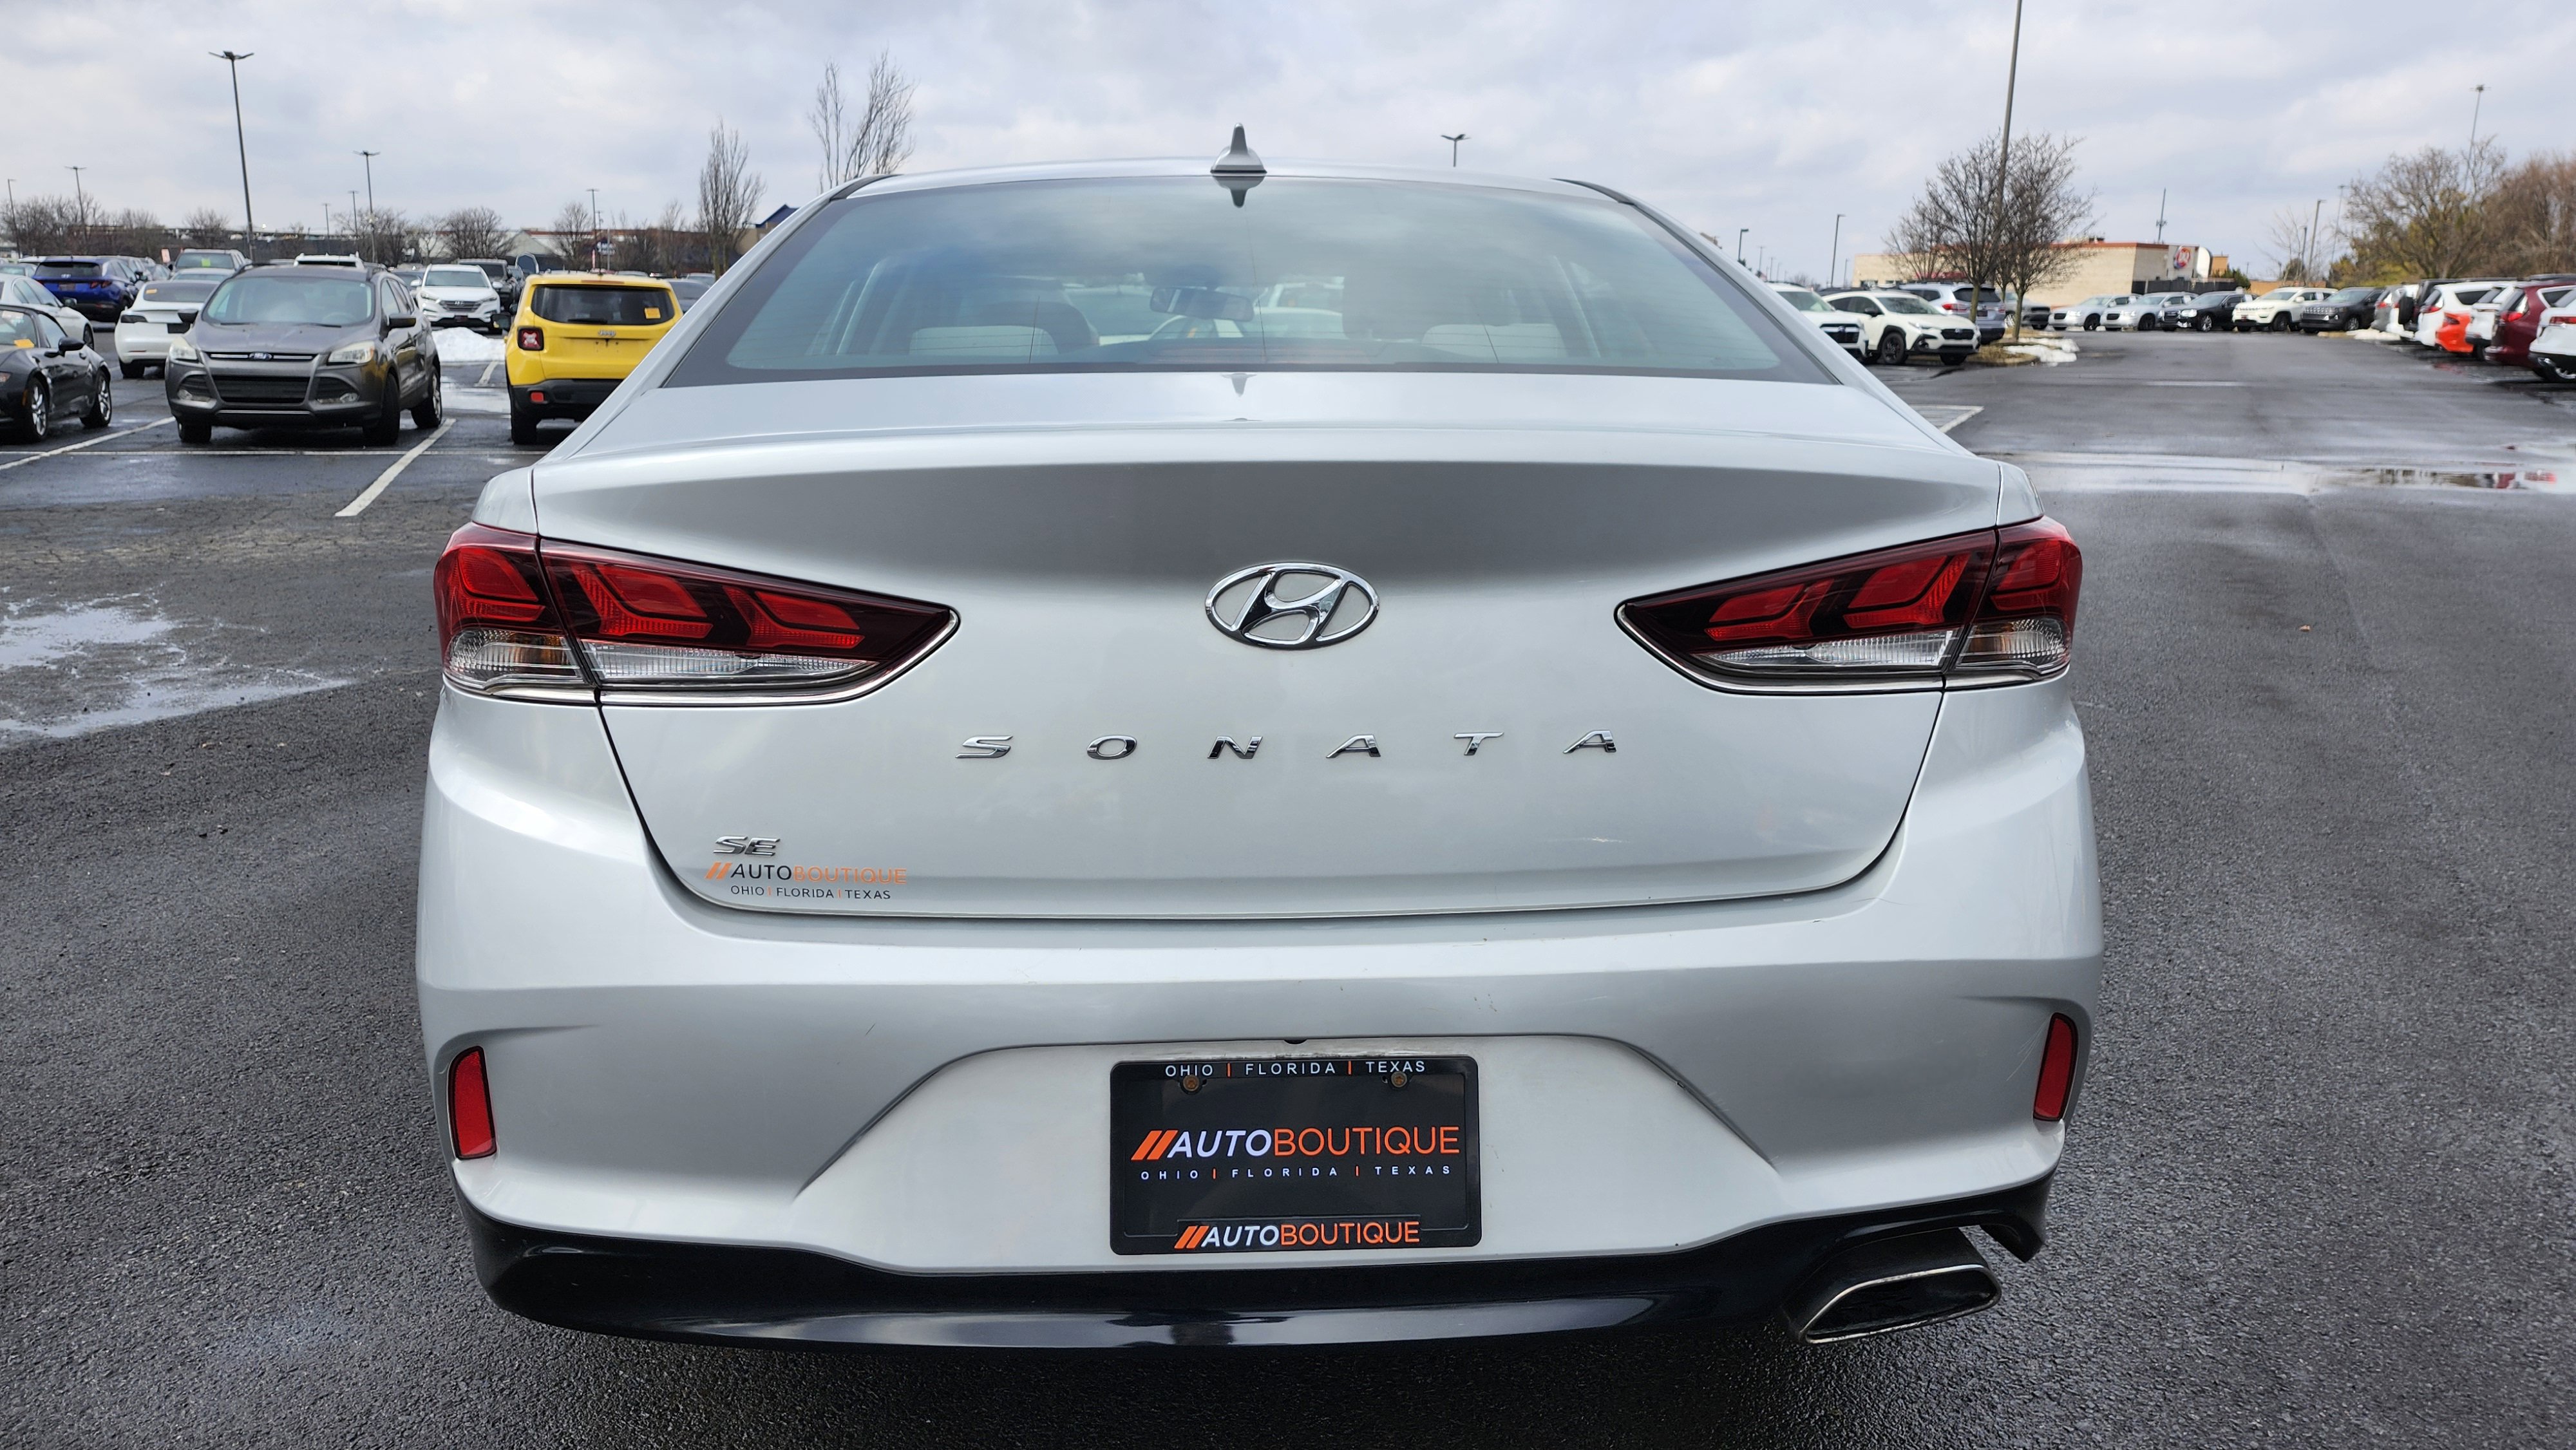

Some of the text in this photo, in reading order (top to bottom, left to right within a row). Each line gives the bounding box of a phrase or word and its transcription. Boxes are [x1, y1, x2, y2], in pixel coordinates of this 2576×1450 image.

[955, 730, 1618, 759] SONATA
[713, 836, 781, 857] SE
[730, 863, 907, 884] AUTOBOUTIQUE
[730, 885, 891, 899] OHIO FLORIDA TEXAS
[1165, 1060, 1425, 1077] OHIO FLORIDA TEXAS
[1167, 1126, 1460, 1158] AUTOBOUTIQUE
[1141, 1165, 1451, 1180] OHIO FLORIDA TEXAS
[1201, 1221, 1421, 1248] AUTOBOUTIQUE
